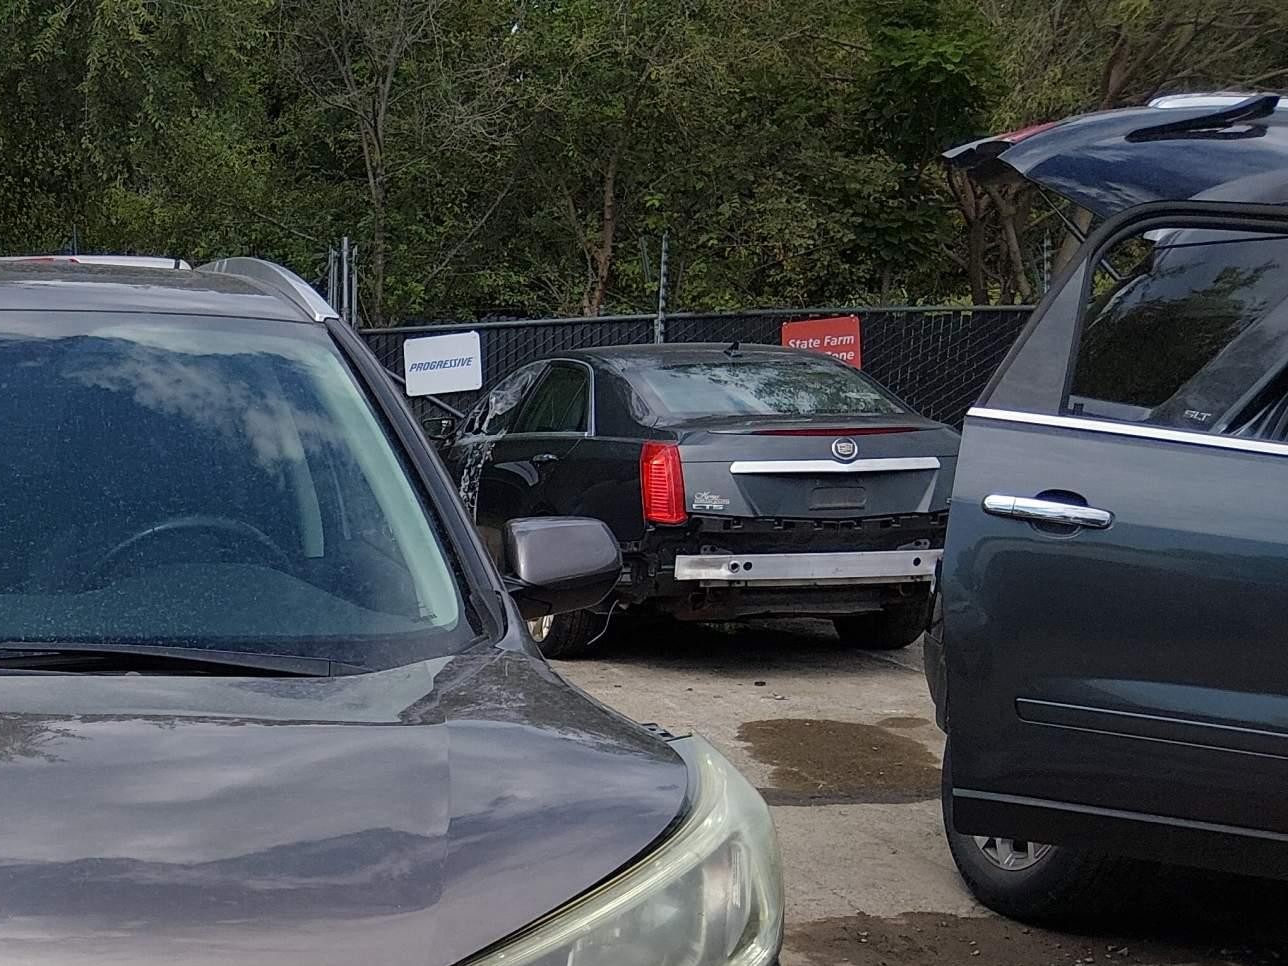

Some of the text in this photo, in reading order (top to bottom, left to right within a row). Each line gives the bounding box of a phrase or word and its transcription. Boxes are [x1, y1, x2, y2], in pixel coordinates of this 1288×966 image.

[788, 335, 855, 349] State Farm
[826, 351, 855, 360] one
[409, 356, 474, 372] PROGRESSIVE
[1184, 409, 1212, 421] SLT
